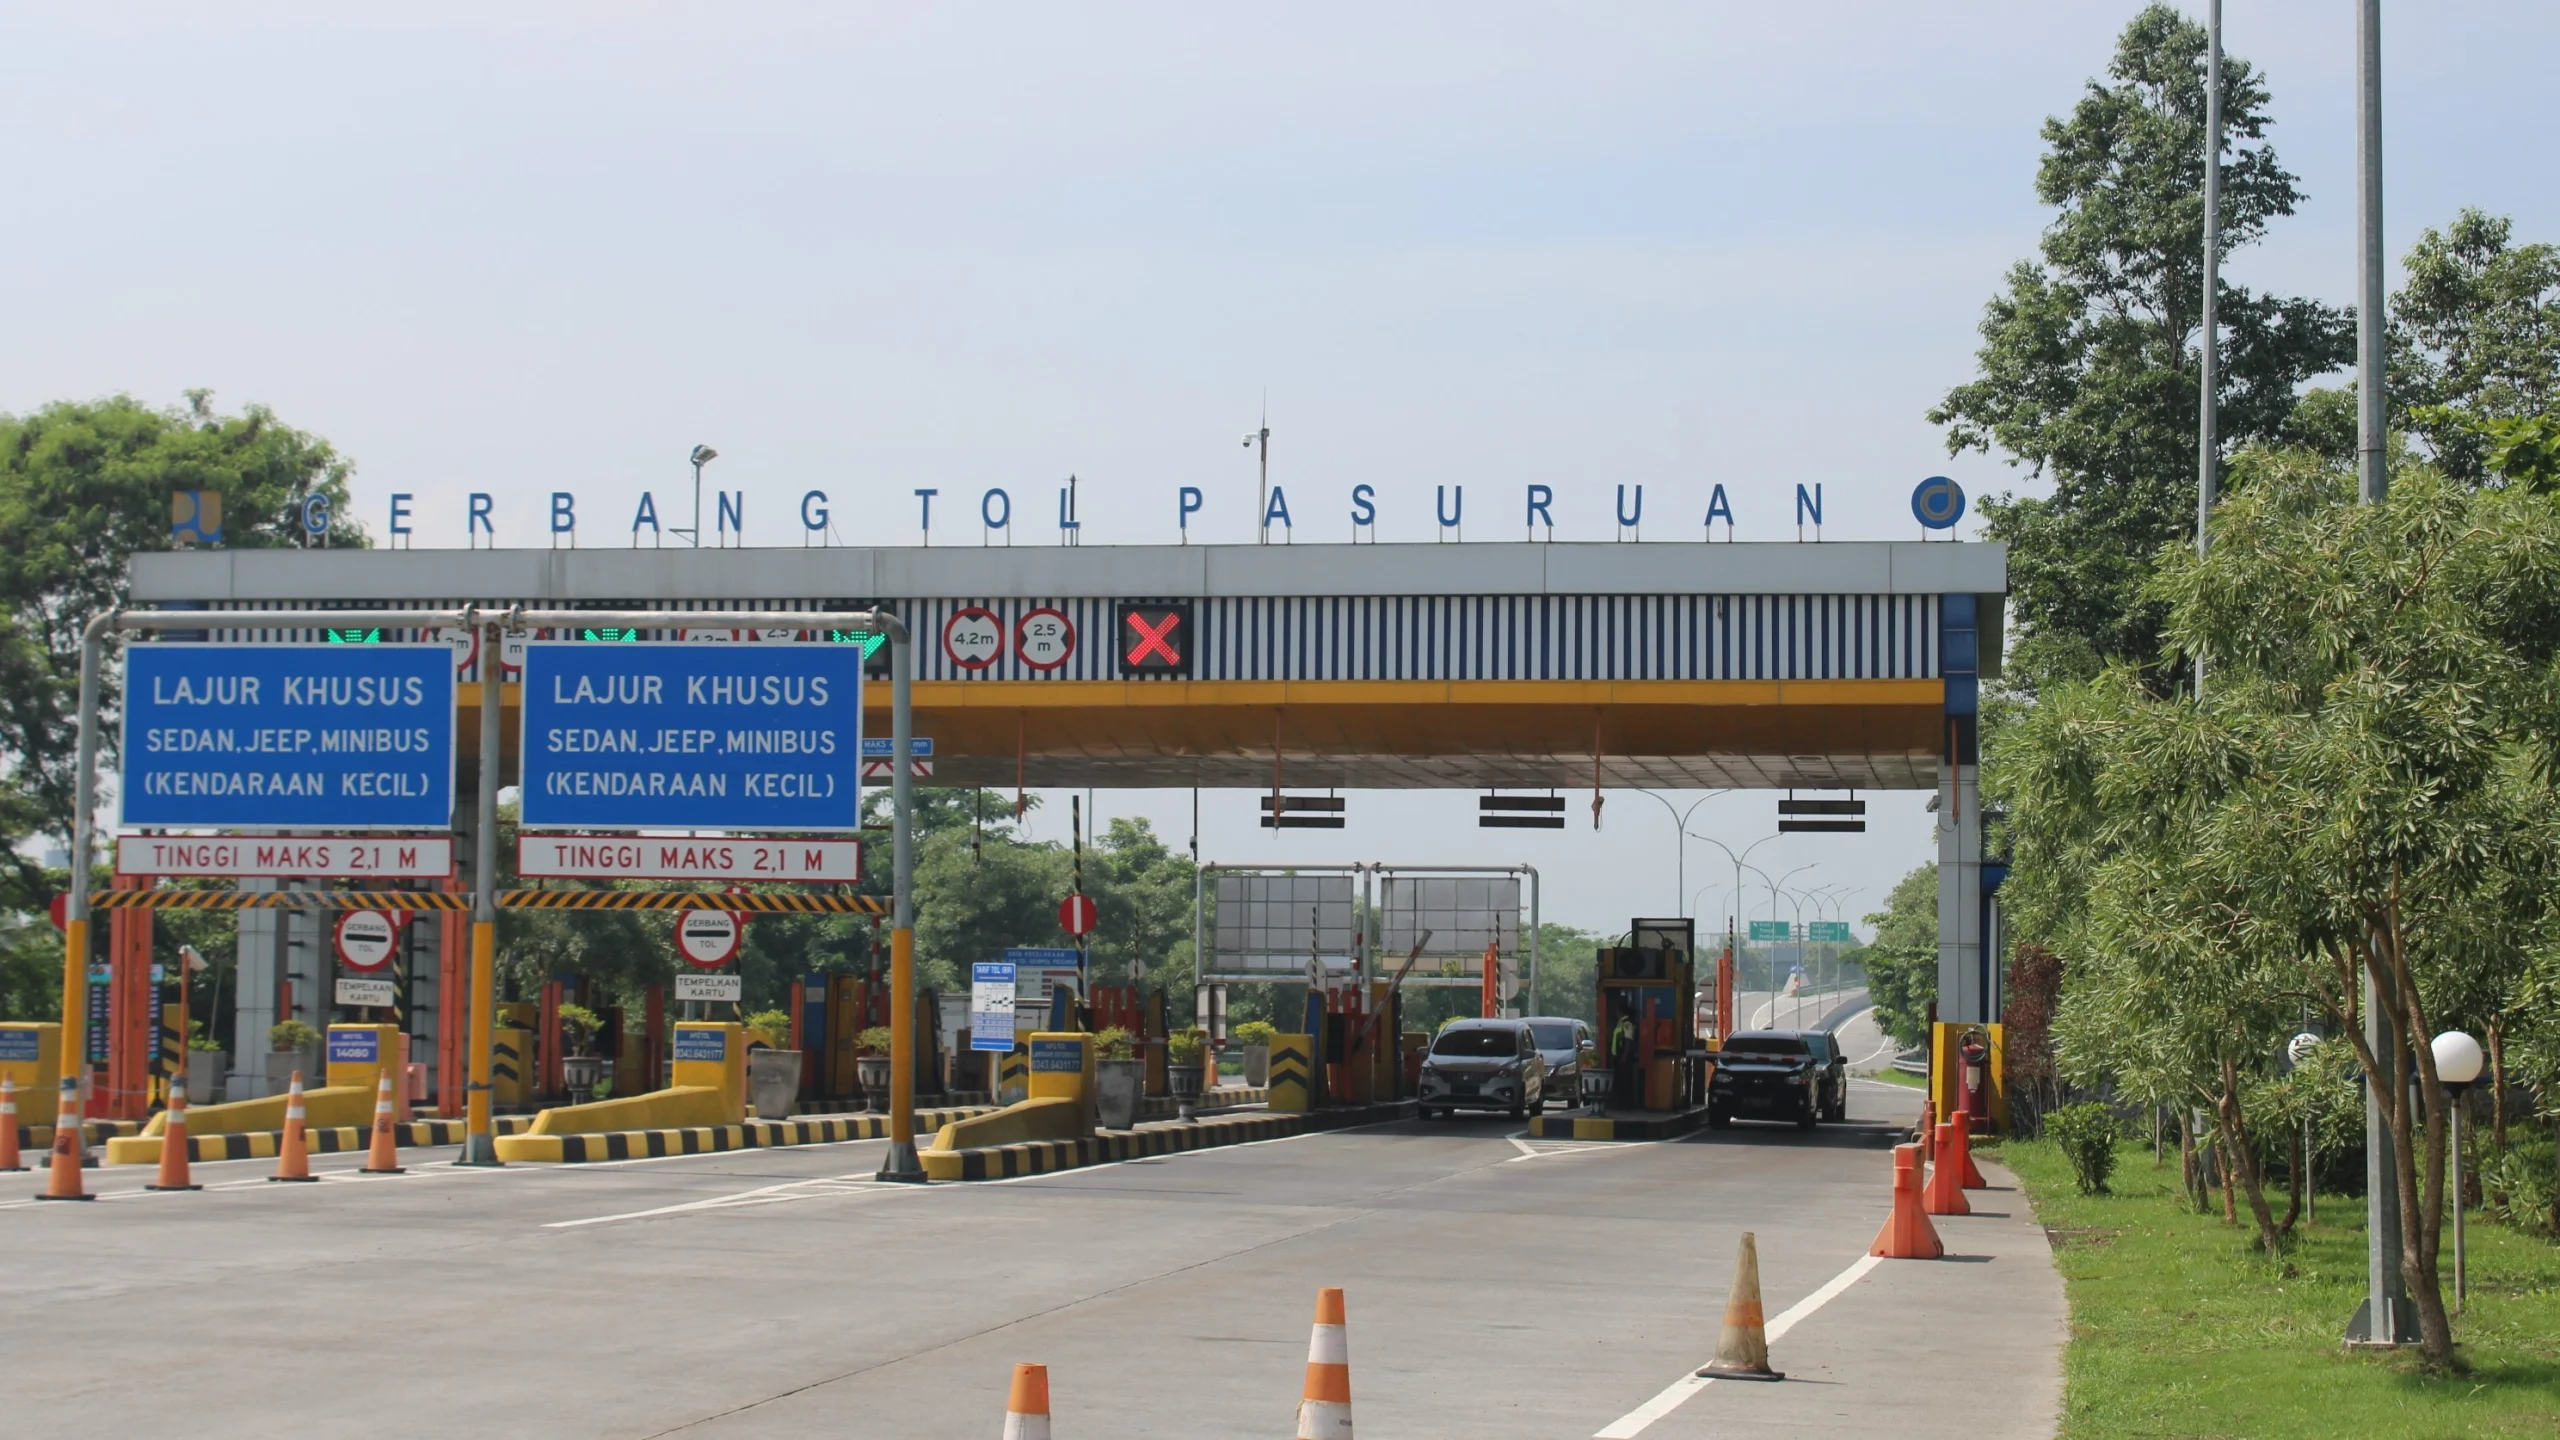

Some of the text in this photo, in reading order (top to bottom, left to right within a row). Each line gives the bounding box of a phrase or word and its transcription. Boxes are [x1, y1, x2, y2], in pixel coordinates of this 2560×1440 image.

[302, 484, 1822, 534] GERBANG TOL PASURUAN
[1038, 642, 1051, 652] m
[154, 676, 424, 706] LAJUR KHUSUS
[555, 675, 829, 706] LAJUR KHUSUS
[145, 772, 429, 796] (KENDARAAN KECIL)
[546, 772, 835, 798] (KENDARAAN KECIL)
[153, 844, 417, 870] TINGGI MAKS 2,1 M
[555, 844, 823, 873] TINGGI MAKS 2,1 M
[346, 923, 387, 933] GERBANG
[687, 919, 730, 928] GERBANG
[358, 944, 374, 953] TOL
[700, 940, 717, 948] TOL
[991, 966, 1001, 974] TOL
[338, 981, 393, 992] TEMPELKAN
[677, 978, 739, 987] TEMPELKAN
[349, 992, 380, 1003] KARTU
[691, 988, 725, 997] KARTU
[336, 1048, 369, 1058] 14080
